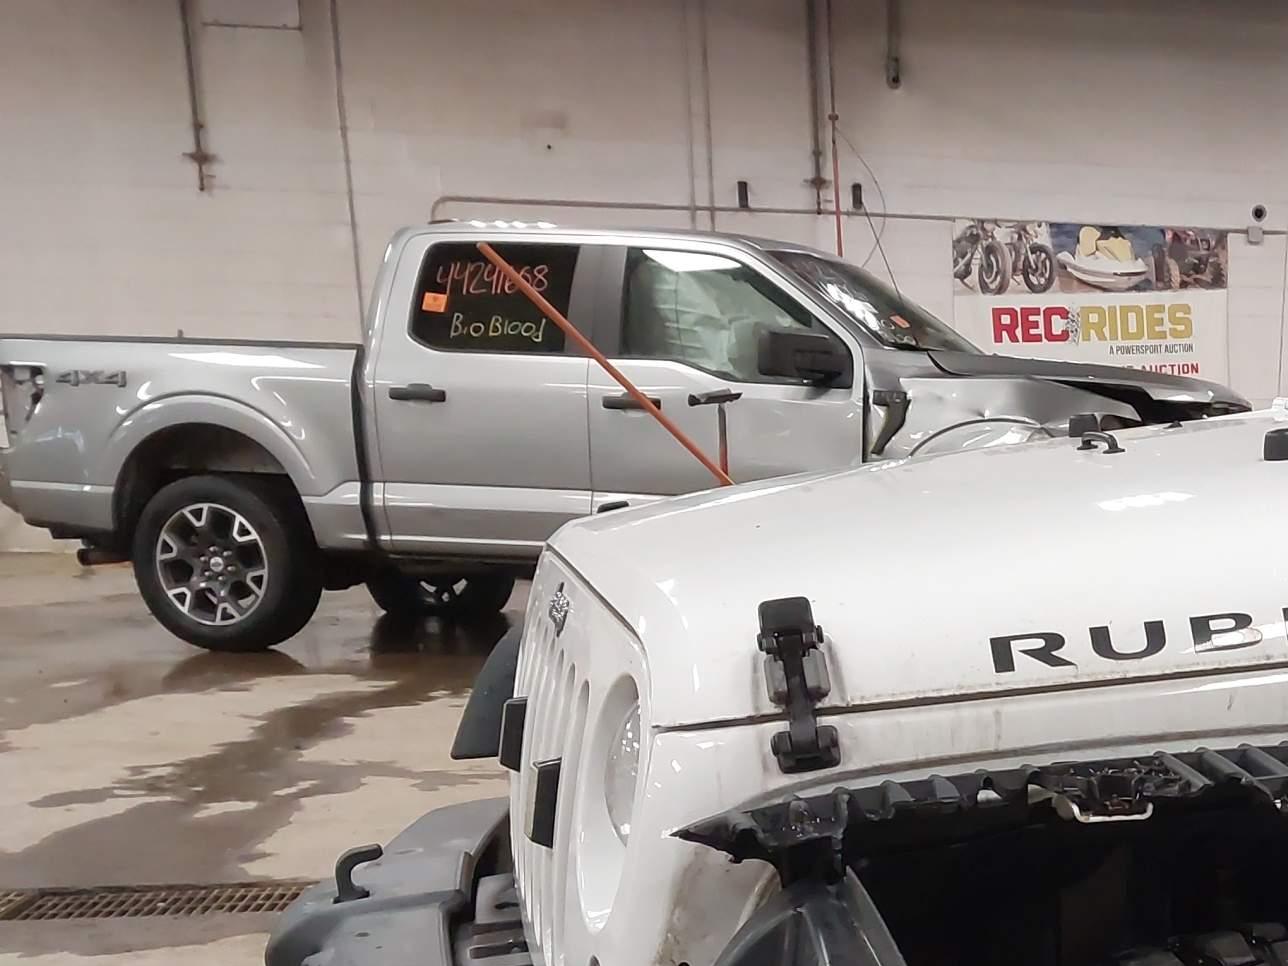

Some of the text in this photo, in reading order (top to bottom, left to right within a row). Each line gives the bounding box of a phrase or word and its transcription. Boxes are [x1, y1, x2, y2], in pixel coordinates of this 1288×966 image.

[991, 303, 1193, 344] REC RIDES
[1109, 342, 1194, 356] A POWERSPORT AUCTION
